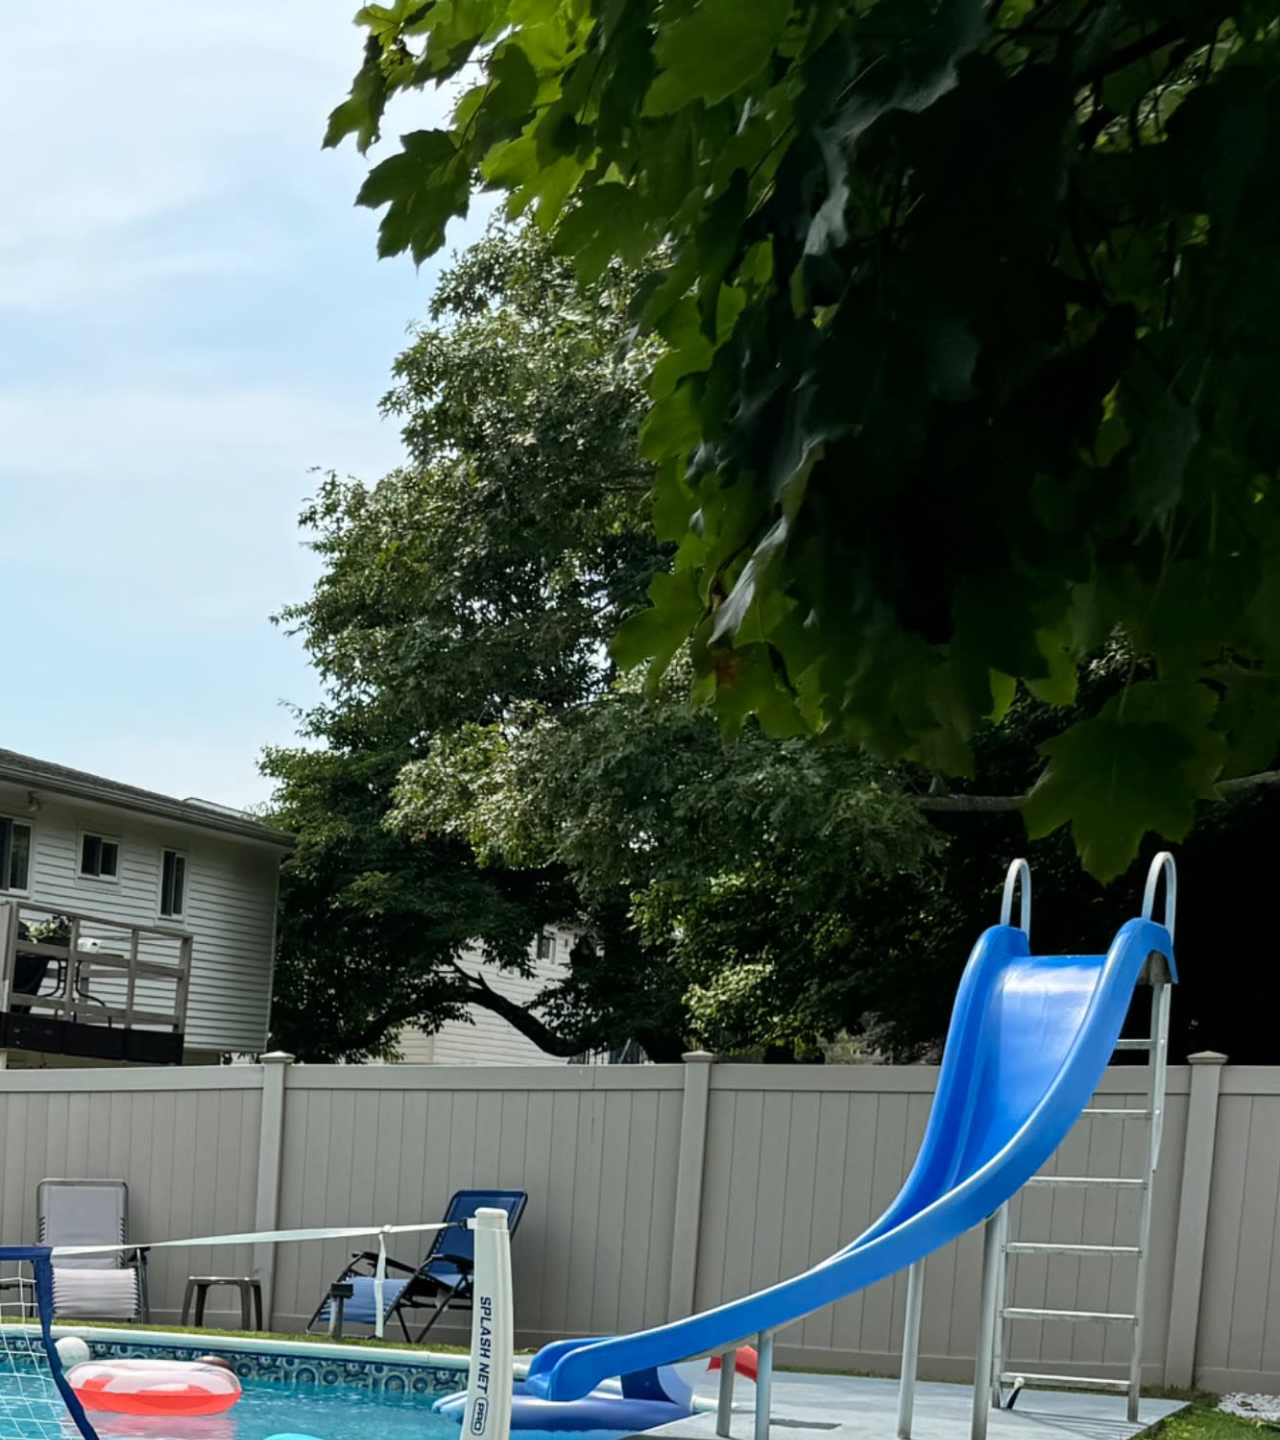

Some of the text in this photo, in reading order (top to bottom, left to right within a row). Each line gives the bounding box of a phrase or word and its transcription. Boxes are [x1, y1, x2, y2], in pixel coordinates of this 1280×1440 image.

[473, 1296, 492, 1431] SPLASH NET PRO
